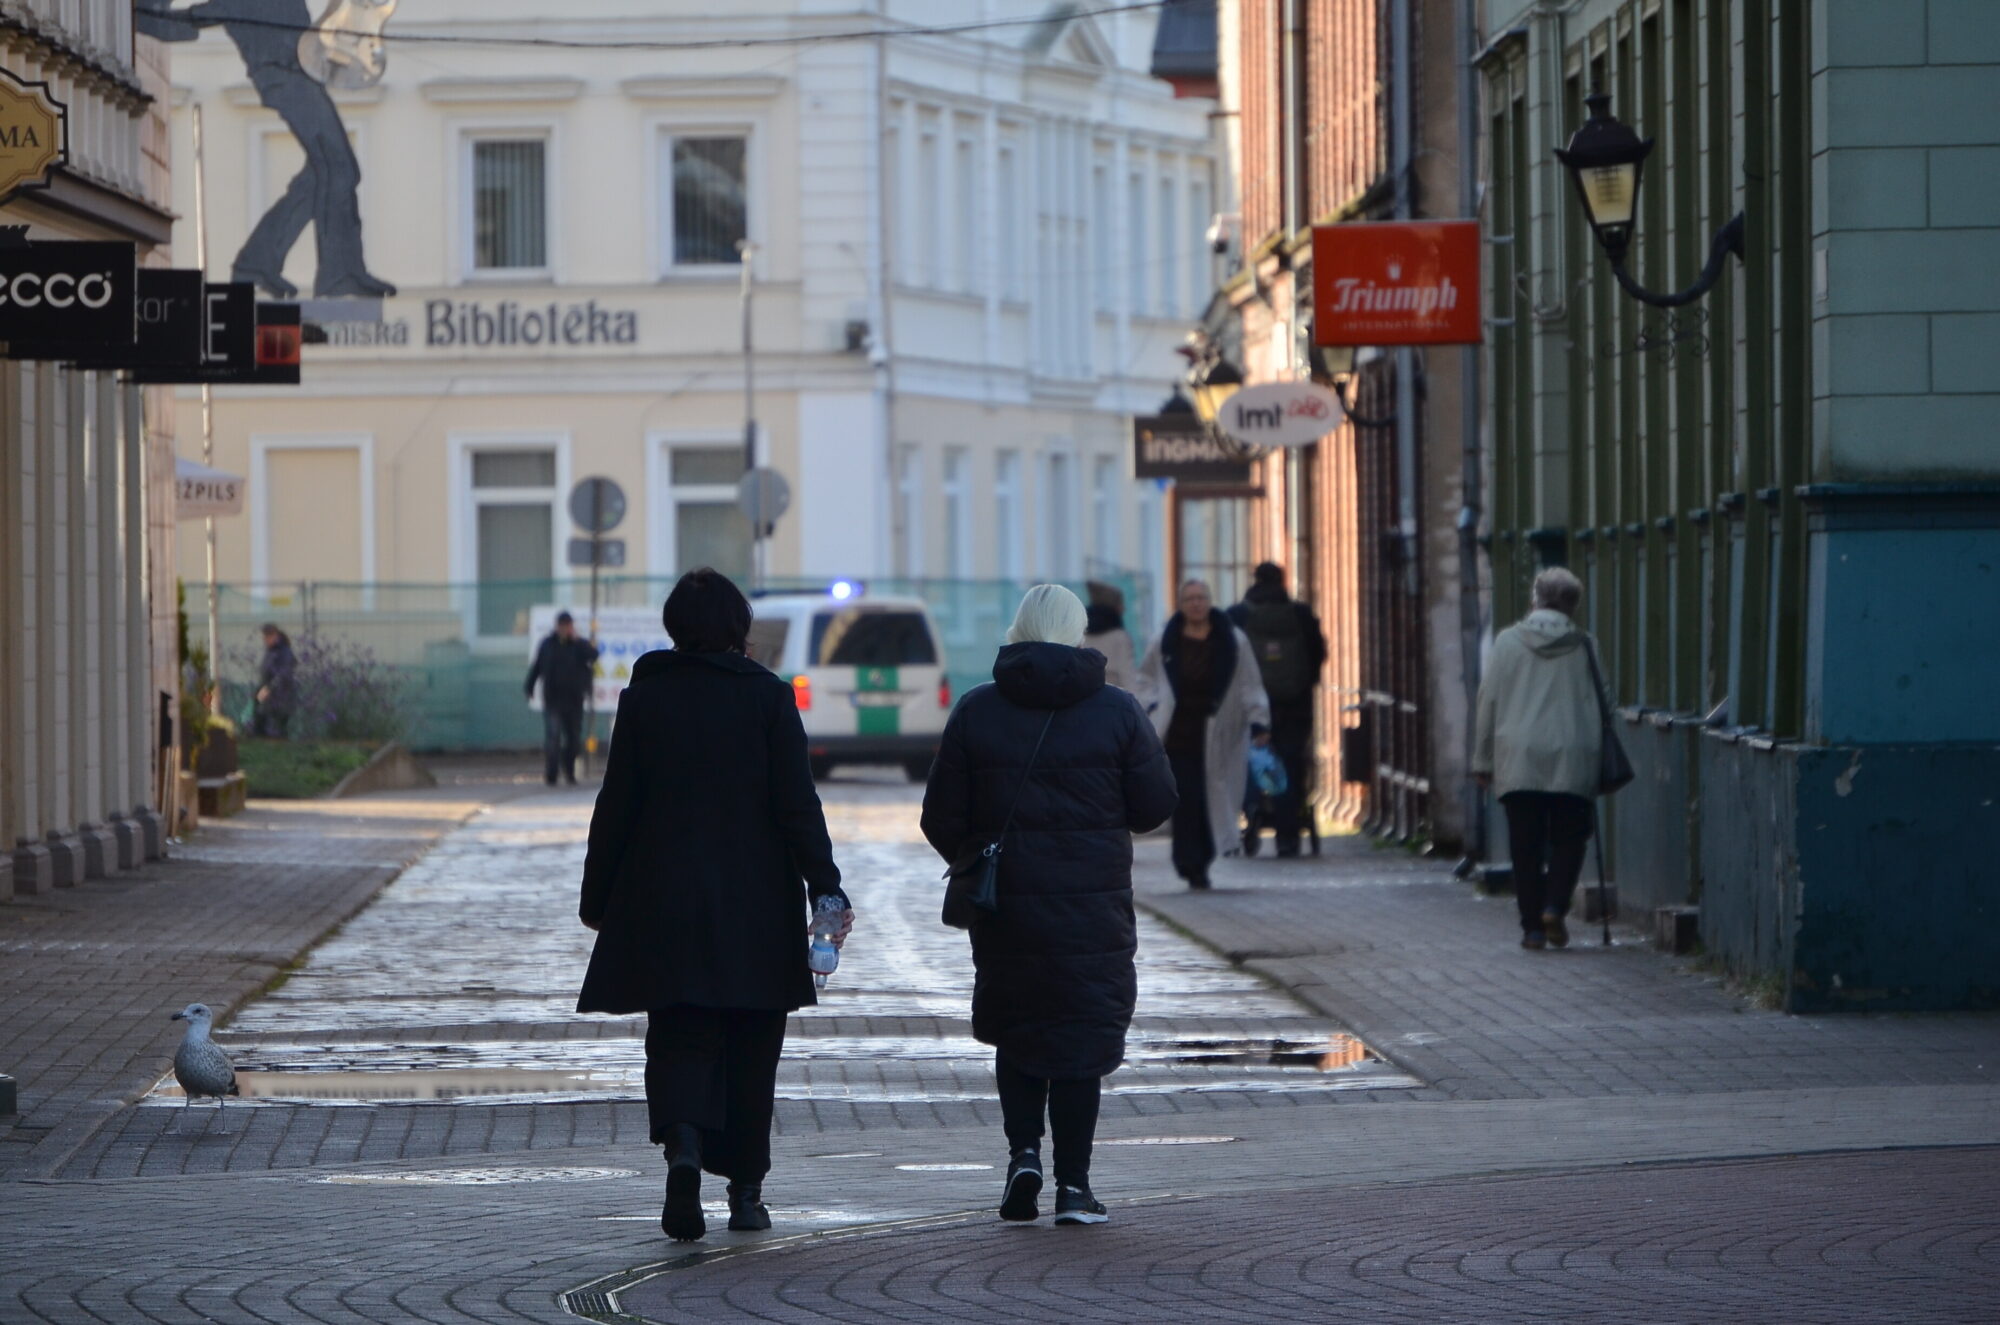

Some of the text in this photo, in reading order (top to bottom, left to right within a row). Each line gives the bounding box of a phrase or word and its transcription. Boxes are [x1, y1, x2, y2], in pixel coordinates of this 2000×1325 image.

[0, 272, 112, 308] cco
[1331, 276, 1457, 317] Triumph
[425, 300, 639, 346] Bibliotēka
